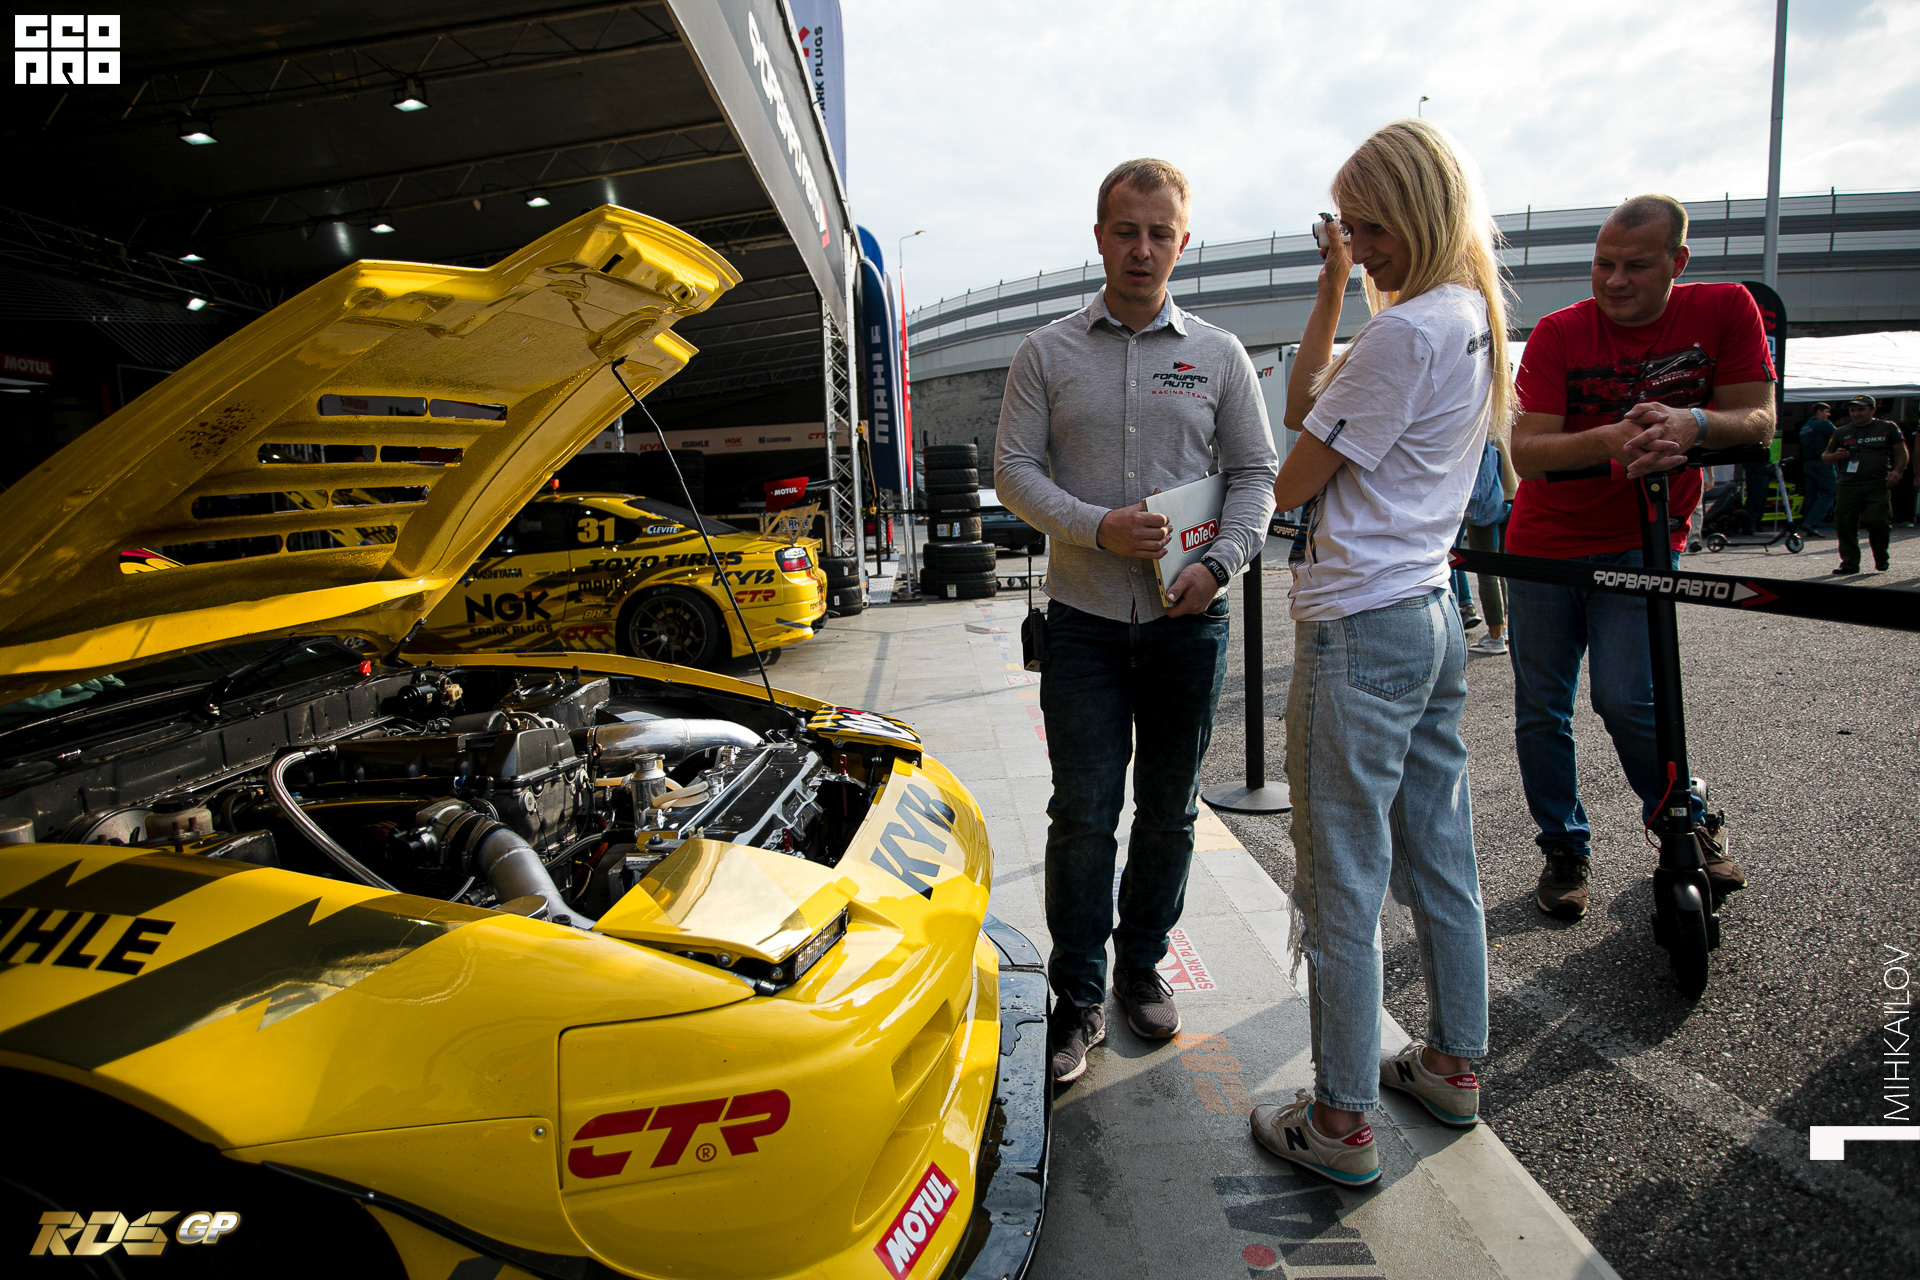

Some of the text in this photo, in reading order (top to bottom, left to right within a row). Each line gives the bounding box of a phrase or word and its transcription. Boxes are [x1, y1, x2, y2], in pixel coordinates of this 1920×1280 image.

[814, 26, 826, 124] ARK PLUGS
[4, 356, 52, 375] MOTUL
[870, 325, 889, 444] MAHLE
[1152, 373, 1208, 383] FORWARD
[1163, 380, 1195, 389] AUTO
[1186, 391, 1208, 400] TEAM
[682, 440, 709, 448] MAHLE
[774, 487, 798, 496] MOTUL
[577, 516, 616, 543] 31
[647, 525, 679, 535] CLEVITE
[1185, 523, 1216, 549] MoTeC
[589, 552, 744, 573] TOYO TIRES
[1208, 560, 1226, 582] PILOT
[473, 568, 523, 580] KASHIYAMA
[711, 569, 776, 587] KYB
[1593, 569, 1730, 600] ФОРВАРД АВТО
[578, 578, 629, 593] MAHLE
[735, 588, 776, 603] CTR
[465, 591, 551, 623] NGK
[470, 624, 553, 637] SPARK PLUGS
[564, 625, 609, 641] CTR
[870, 783, 957, 900] KYB
[1168, 928, 1196, 957] PLUGS
[1184, 958, 1214, 990] SPARK
[1395, 1060, 1416, 1083] N
[567, 1089, 791, 1179] CTR
[1284, 1126, 1310, 1151] N
[885, 1172, 953, 1275] MOTUL
